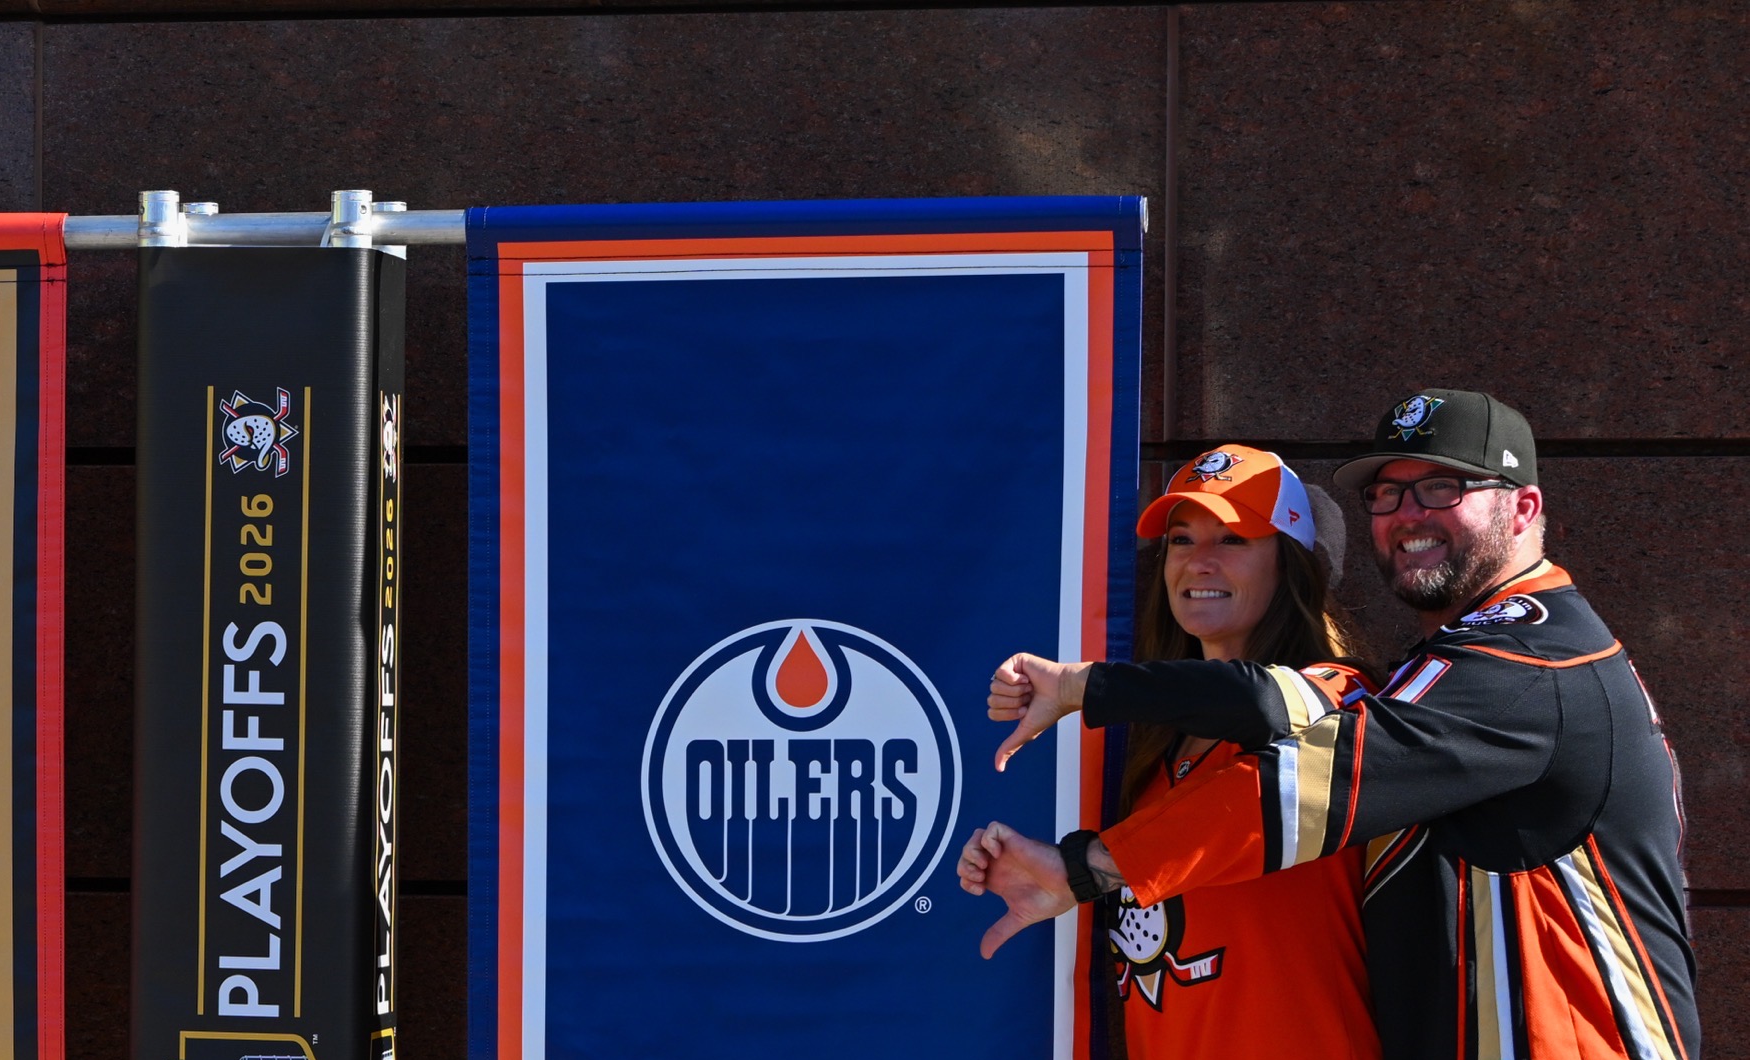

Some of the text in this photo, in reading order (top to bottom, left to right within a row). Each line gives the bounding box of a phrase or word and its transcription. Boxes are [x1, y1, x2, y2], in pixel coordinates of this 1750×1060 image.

[218, 493, 287, 1017] PLAYOFFS 2026
[376, 498, 395, 1016] PLAYOFFS 2026
[686, 738, 918, 860] OILERS
